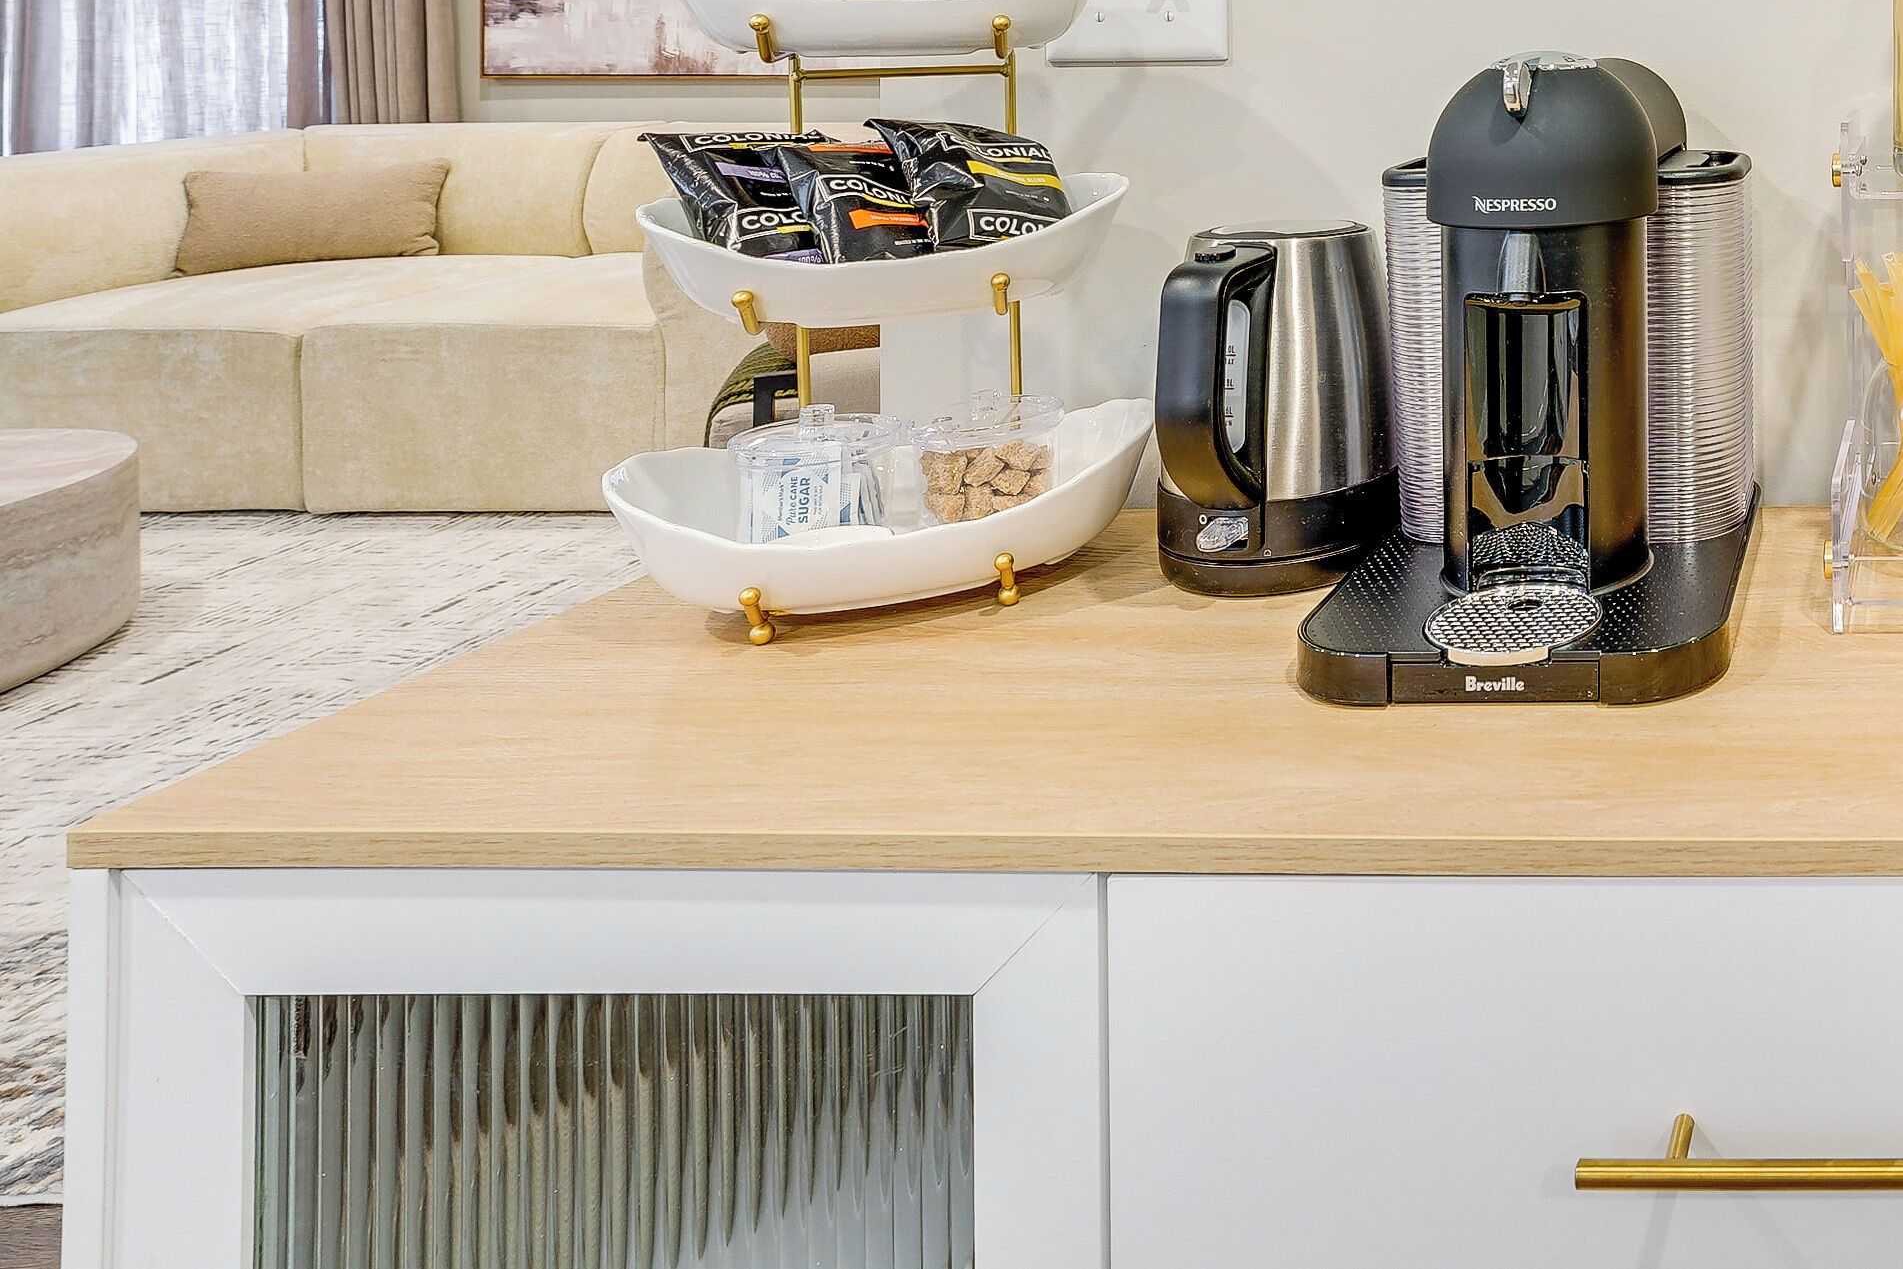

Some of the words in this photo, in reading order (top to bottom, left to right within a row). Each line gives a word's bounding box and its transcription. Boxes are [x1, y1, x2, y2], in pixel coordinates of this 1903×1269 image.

[1471, 195, 1558, 214] NESPRESSO
[789, 476, 798, 501] CANE
[797, 477, 811, 524] SUGAR
[1465, 675, 1526, 692] Breville
